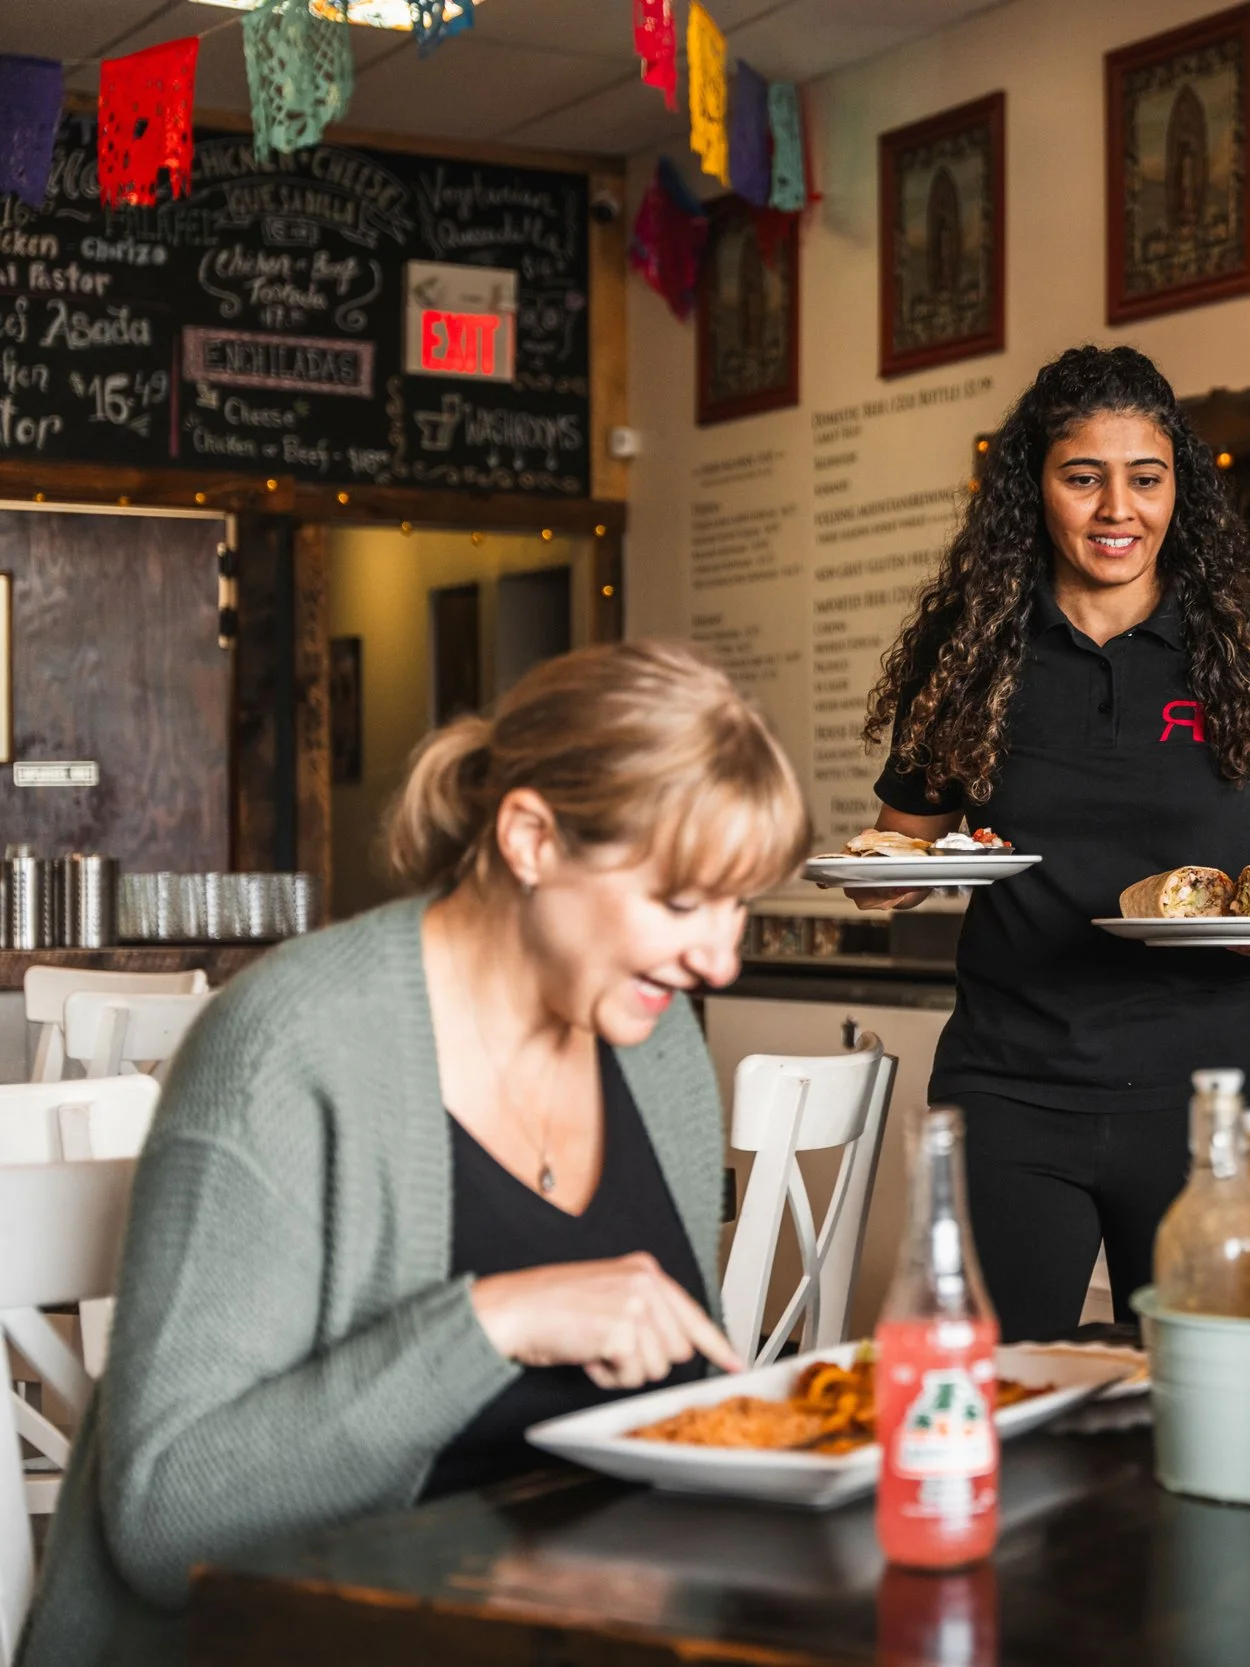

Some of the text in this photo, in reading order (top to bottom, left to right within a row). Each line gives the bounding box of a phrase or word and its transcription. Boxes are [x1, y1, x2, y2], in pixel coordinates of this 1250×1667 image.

[38, 298, 152, 351] Asada
[422, 310, 500, 375] EXIT
[205, 340, 357, 384] ENCHILADAS
[224, 396, 298, 429] Cheese
[464, 404, 583, 450] WASHROOMS
[193, 425, 258, 457] Chicken
[282, 434, 331, 476] Beef
